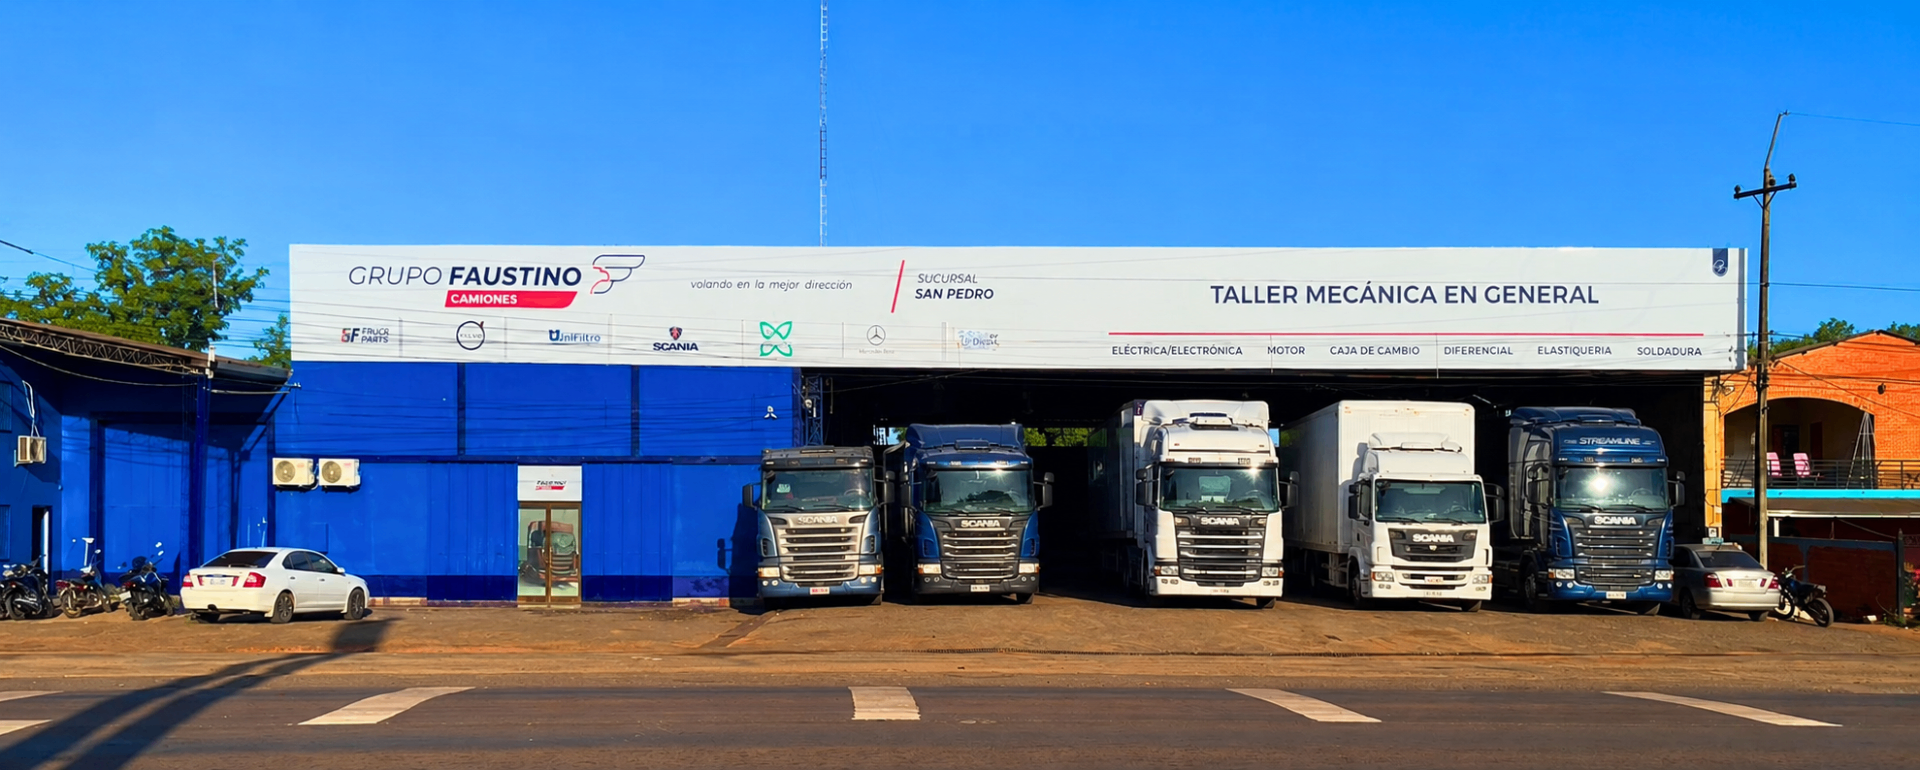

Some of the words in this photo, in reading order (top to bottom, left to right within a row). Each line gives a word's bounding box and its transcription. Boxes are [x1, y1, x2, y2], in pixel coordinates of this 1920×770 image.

[349, 266, 442, 285] GRUPO
[449, 267, 581, 286] FAUSTINO
[918, 274, 977, 283] SUCURSAL
[691, 280, 732, 289] volando
[755, 280, 764, 289] la
[769, 280, 799, 291] mejor
[805, 280, 852, 289] dirección
[915, 289, 943, 299] SAN
[947, 289, 994, 299] PEDRO
[1211, 286, 1297, 303] TALLER
[1307, 281, 1437, 303] MECÁNICA
[1445, 286, 1476, 303] EN
[1485, 286, 1599, 303] GENERAL
[451, 294, 517, 304] CAMIONES
[652, 341, 700, 352] SCANIA
[1112, 344, 1242, 355] ELÉCTRICA/ELECTRÓNICA
[1268, 346, 1305, 354] MOTOR
[1330, 346, 1357, 355] CAJA
[1361, 346, 1374, 355] DE
[1377, 346, 1419, 355] CAMBIO
[1444, 346, 1513, 355] DIFERENCIAL
[1538, 346, 1612, 356] ELASTIQUERIA
[1638, 347, 1702, 356] SOLDADURA
[798, 515, 838, 524] SCANIA
[961, 520, 1001, 528] SCANIA
[1200, 516, 1240, 526] SCANIA
[1594, 516, 1637, 525] SCANIA
[1412, 533, 1455, 543] SCANIA
